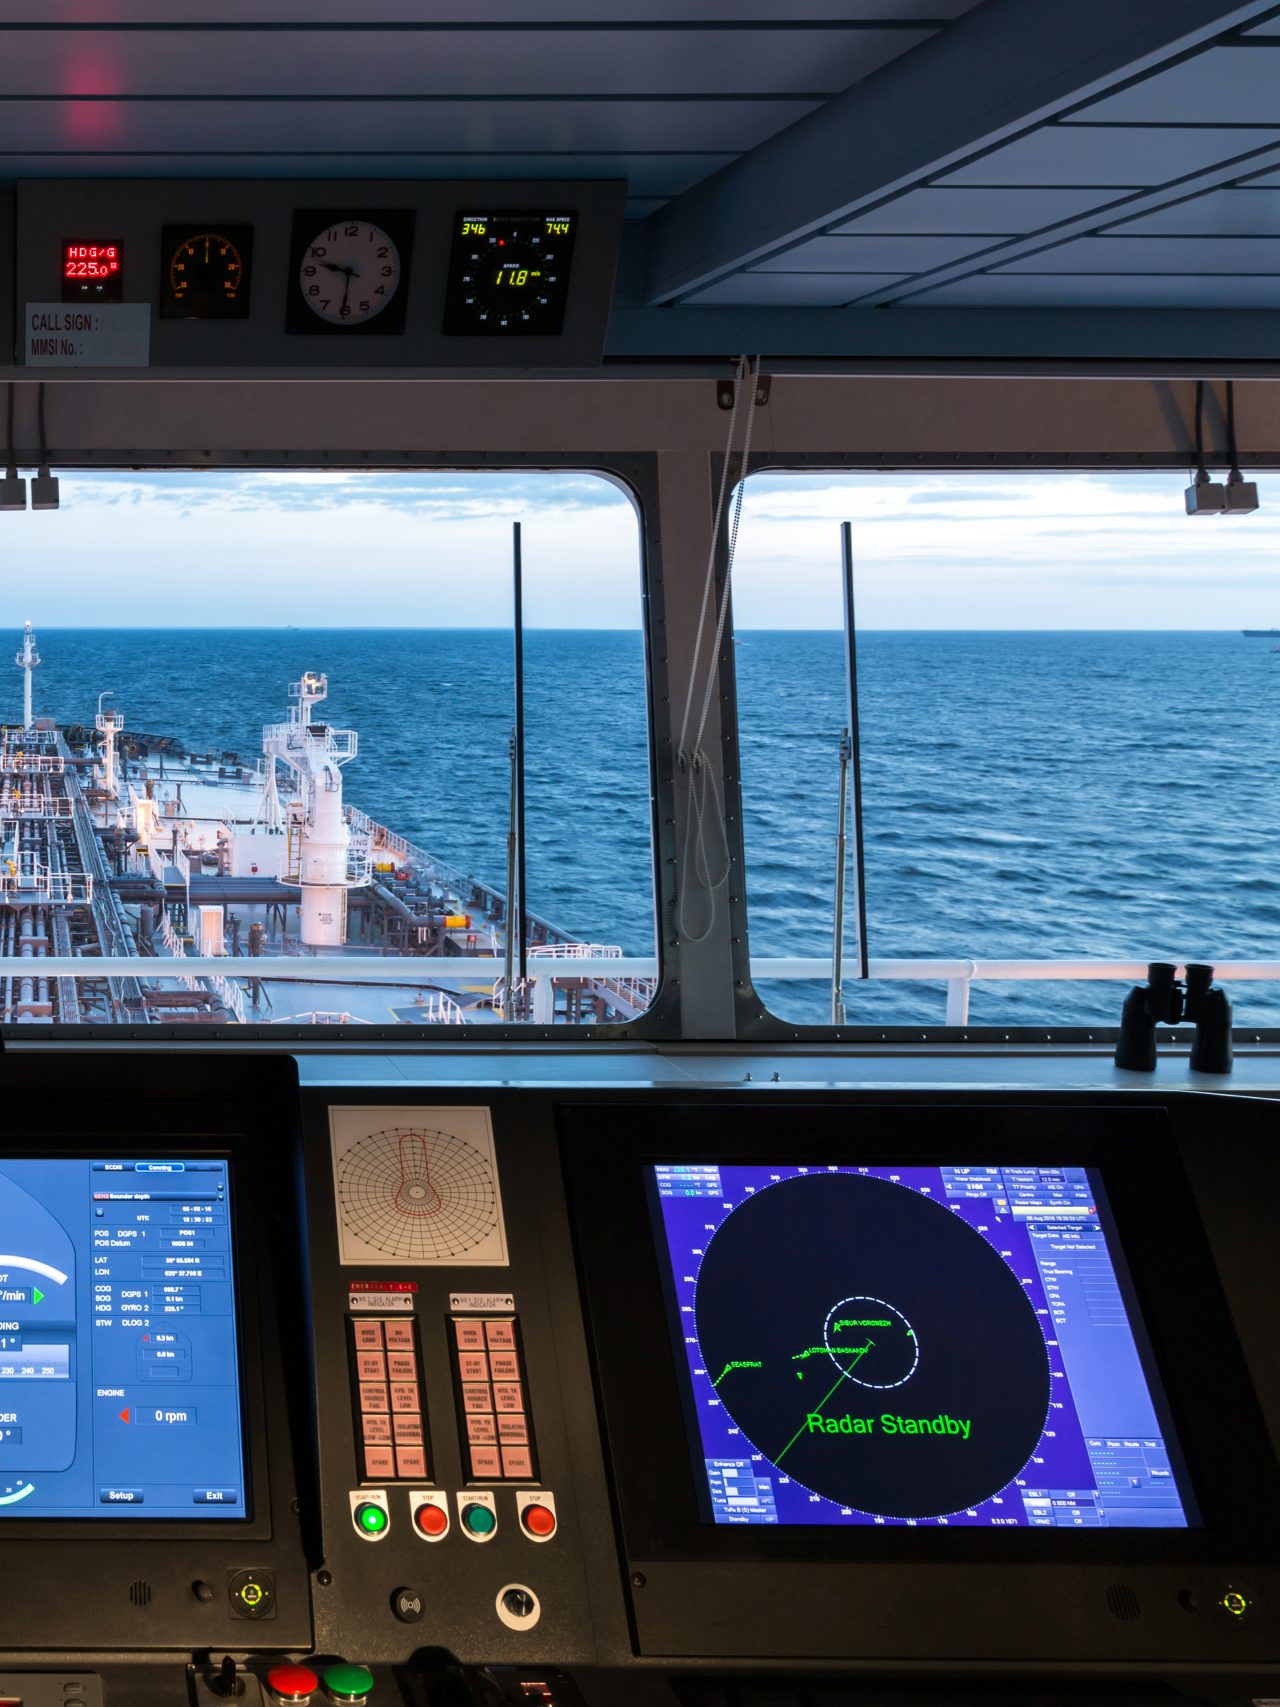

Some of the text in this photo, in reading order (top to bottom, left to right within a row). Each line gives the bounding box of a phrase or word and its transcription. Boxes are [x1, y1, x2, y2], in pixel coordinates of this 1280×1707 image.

[344, 226, 359, 237] 12
[462, 223, 486, 235] 346
[546, 223, 570, 235] 74.4
[328, 231, 337, 242] 11
[369, 231, 374, 242] 1
[68, 246, 116, 258] HDG/G
[311, 247, 326, 258] 10
[377, 247, 389, 258] 2
[304, 266, 317, 277] 9
[381, 266, 392, 277] 3
[496, 270, 529, 286] 11.8
[309, 285, 320, 296] 8
[374, 285, 385, 295] 4
[320, 300, 331, 310] 7
[340, 305, 351, 316] 6
[360, 301, 371, 311] 5
[31, 313, 62, 331] CALL
[64, 313, 92, 331] SIGN
[31, 338, 58, 356] MMSI
[61, 338, 77, 356] No.
[117, 1230, 138, 1238] DGPS
[95, 1304, 149, 1312] HDG GYRO 2
[95, 1319, 150, 1327] STW DLOG 2
[21, 1367, 35, 1375] 240
[97, 1389, 125, 1397] ENGINE
[155, 1410, 187, 1423] 0 rpm
[806, 1413, 971, 1440] Radar Standby
[109, 1491, 134, 1501] Setup
[206, 1491, 223, 1500] Exit
